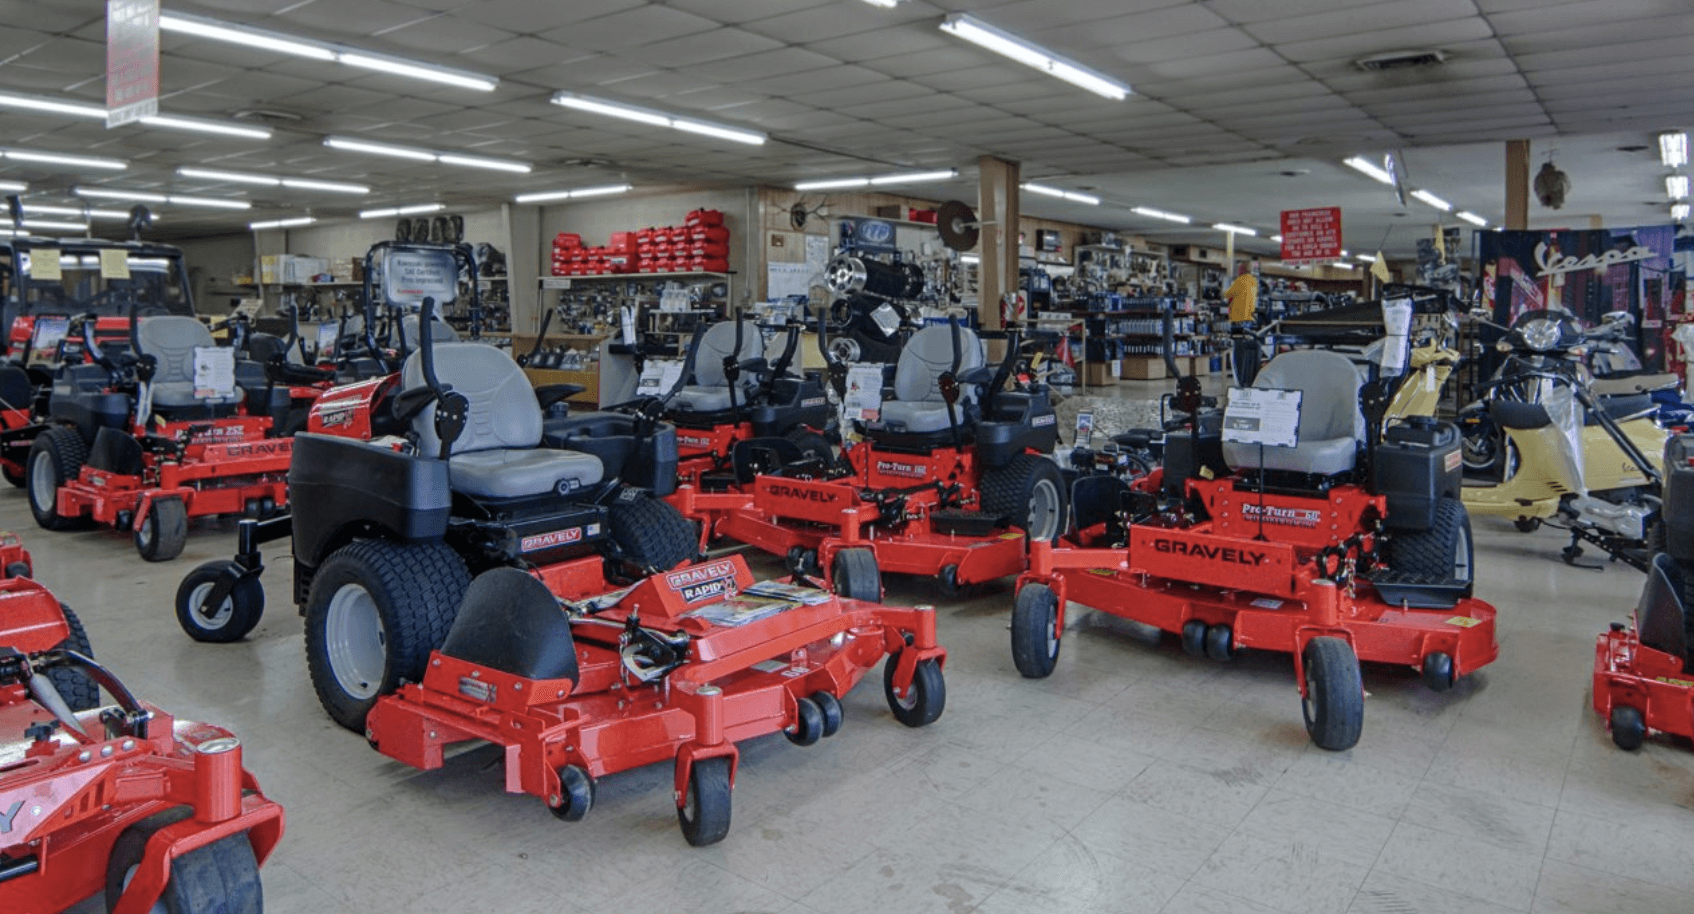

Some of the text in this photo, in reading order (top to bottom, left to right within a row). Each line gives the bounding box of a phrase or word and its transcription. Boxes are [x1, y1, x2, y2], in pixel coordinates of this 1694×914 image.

[1536, 242, 1658, 277] Vespa
[769, 484, 837, 503] GRAVELY
[1242, 503, 1296, 518] Pro-Turn
[522, 529, 580, 550] GRAVELY
[1154, 538, 1266, 567] GRAVELY
[668, 562, 732, 587] GRAVELY
[684, 582, 722, 600] RAPID
